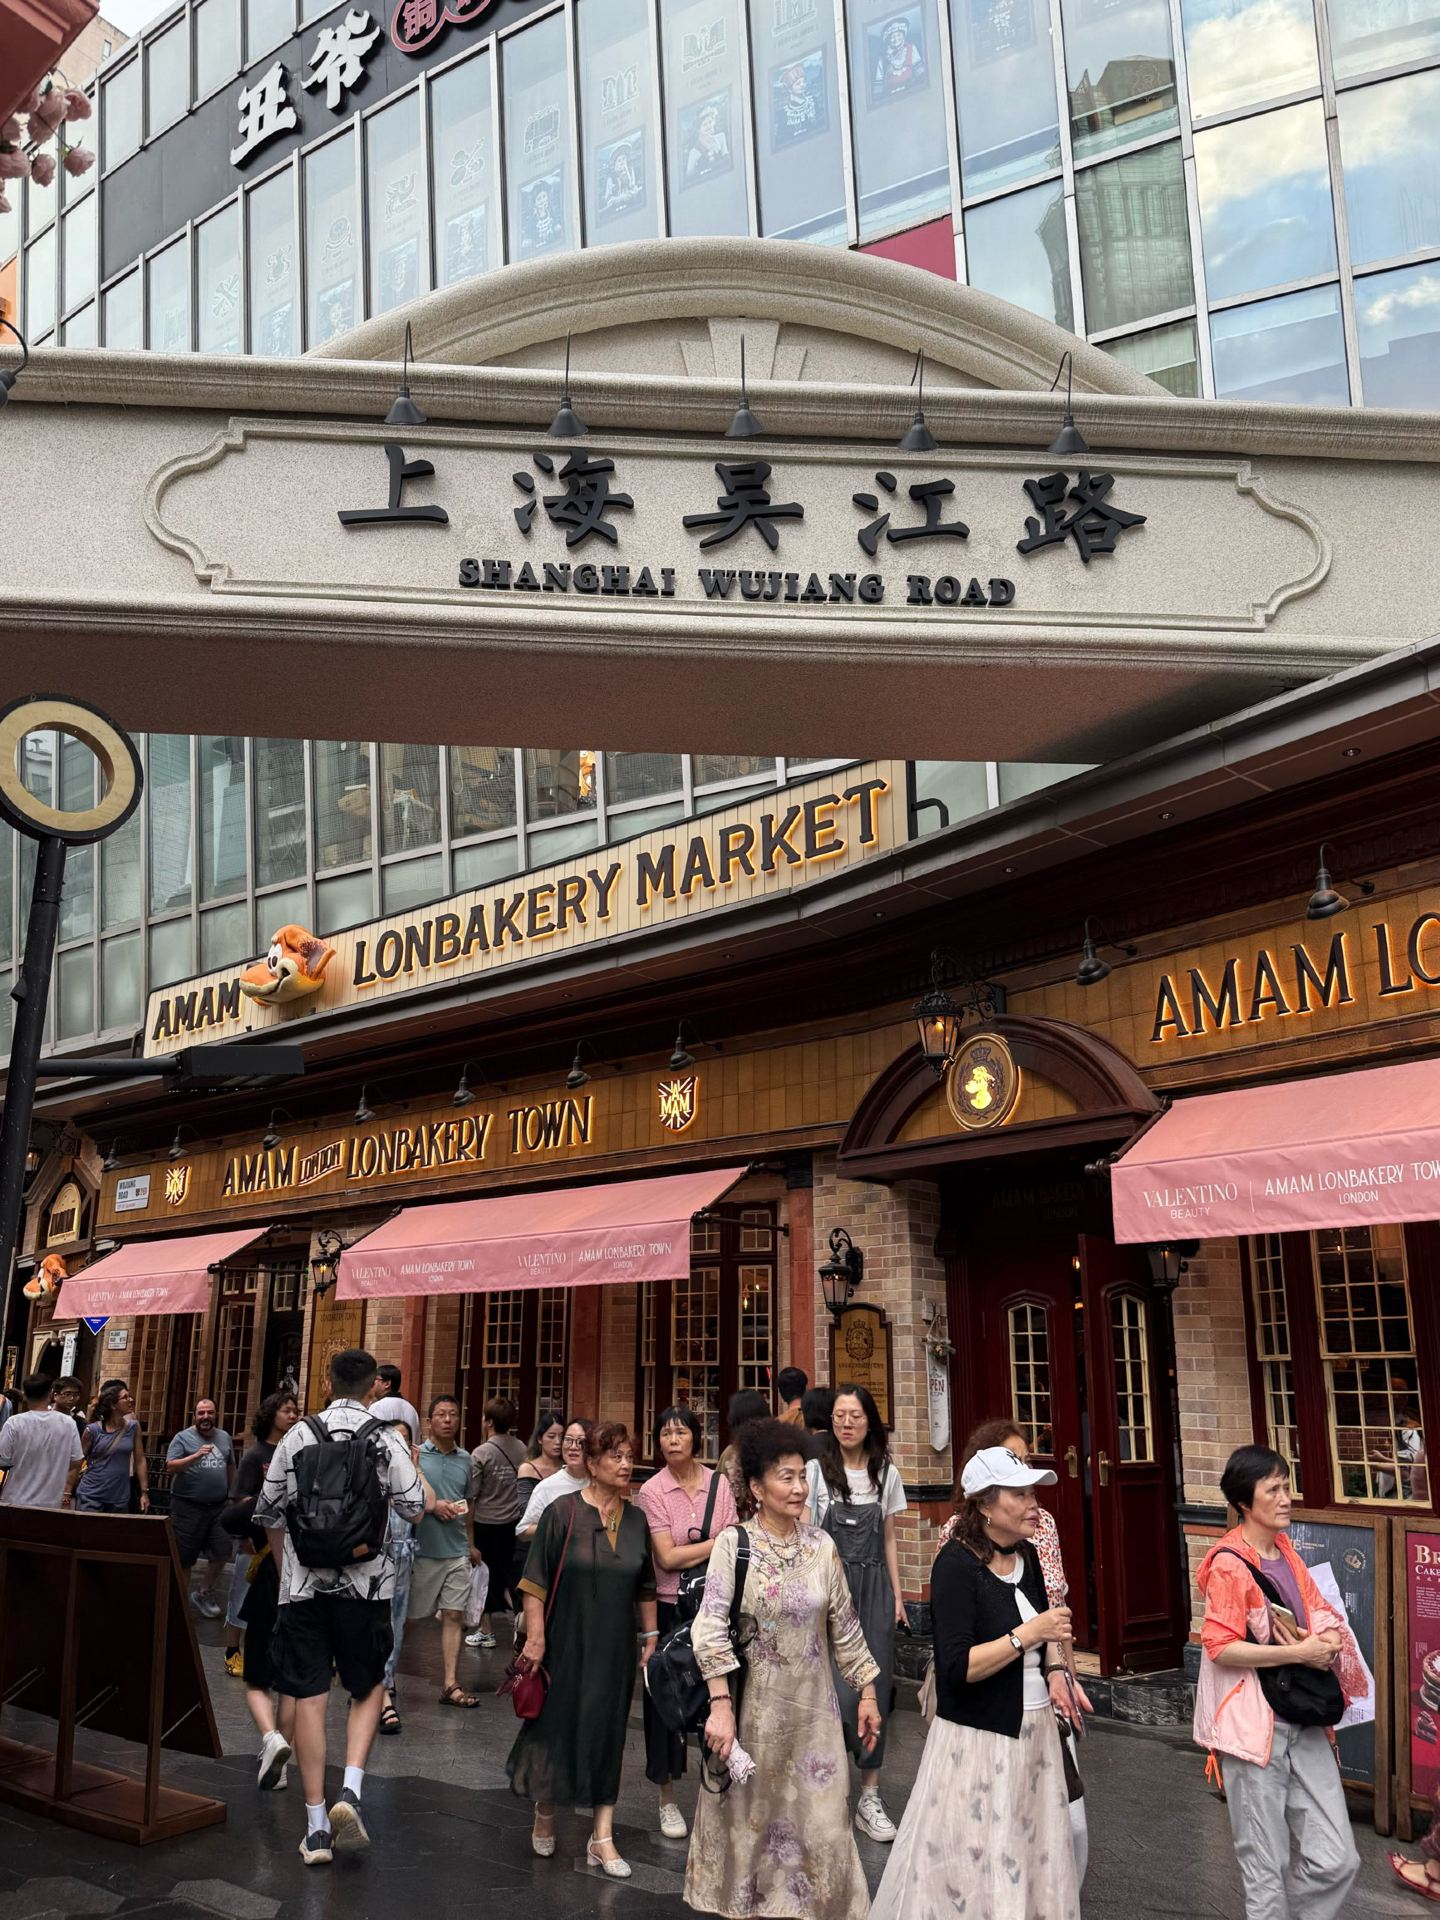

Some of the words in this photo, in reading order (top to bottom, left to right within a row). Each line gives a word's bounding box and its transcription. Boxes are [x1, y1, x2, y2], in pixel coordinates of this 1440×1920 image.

[230, 8, 381, 166] 丑爷
[336, 444, 1147, 564] 上海吴江路
[458, 557, 676, 597] SHANGHAI
[698, 568, 885, 604] WUJIANG
[906, 573, 1017, 608] ROAD
[151, 977, 241, 1041] AMAM
[353, 862, 622, 988] LONBAKERY
[636, 779, 888, 906] MARKET
[1149, 932, 1355, 1042] AMAM
[221, 1145, 299, 1197] AMAM
[346, 1113, 493, 1179] LONBAKERY
[507, 1095, 593, 1154] TOWN
[1143, 1183, 1239, 1209] VALENTINO
[1264, 1174, 1315, 1196] AMAM
[1317, 1164, 1404, 1191] LONBAKERY
[1339, 1190, 1379, 1205] LONDON
[1170, 1207, 1211, 1219] BEAUTY
[456, 1258, 475, 1272] TOWN
[578, 1250, 604, 1263] AMAM
[604, 1245, 647, 1261] LONBAKERY
[649, 1242, 673, 1257] TOWN
[928, 1378, 945, 1393] PEN
